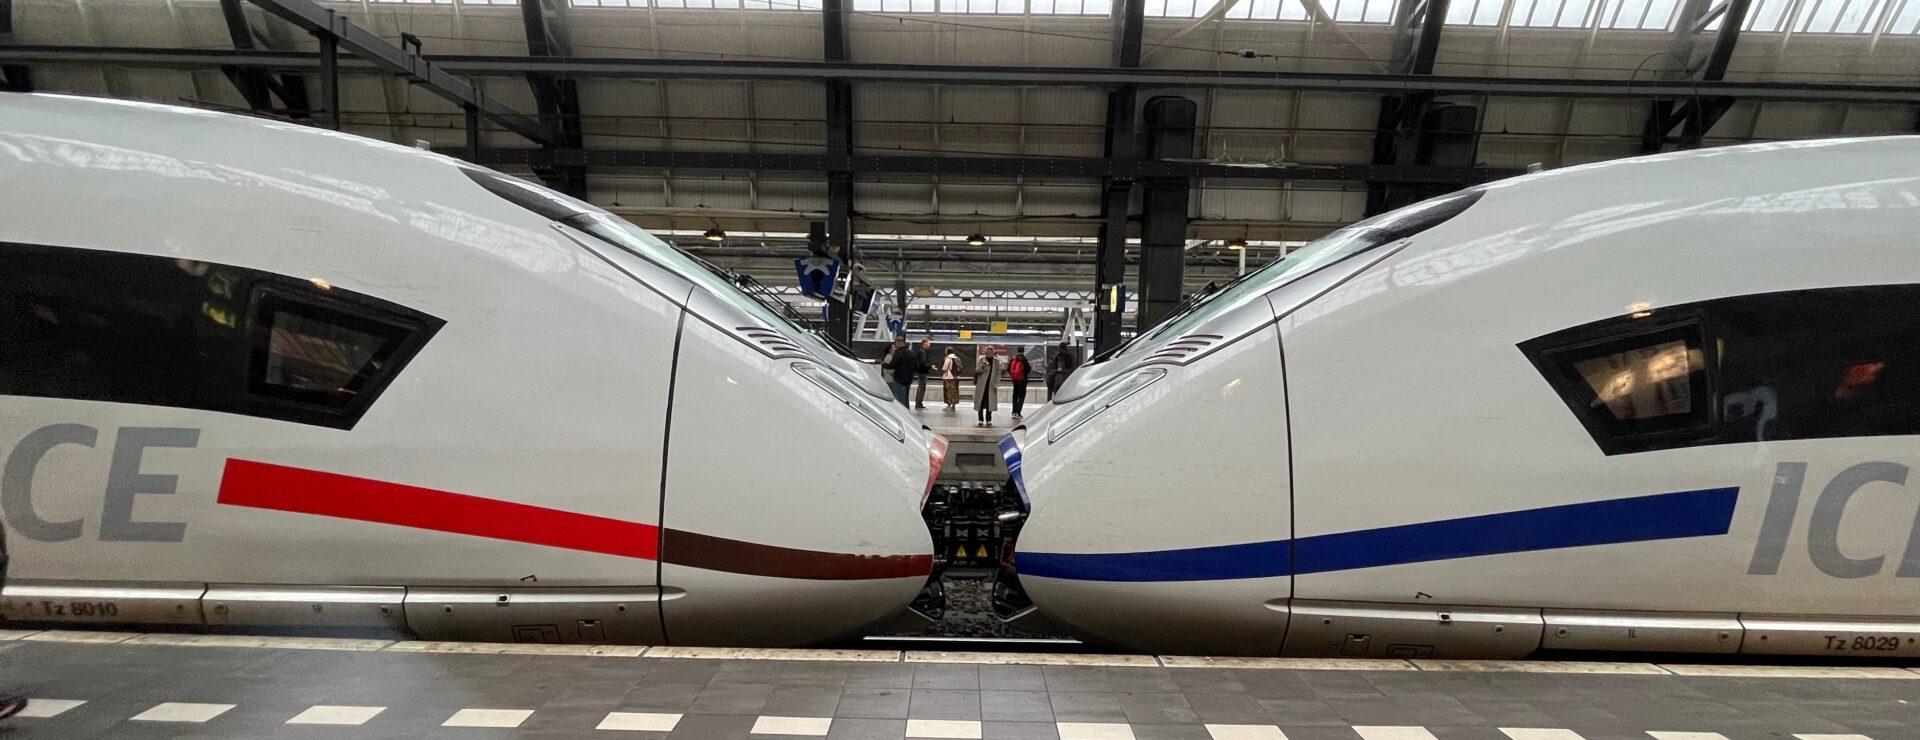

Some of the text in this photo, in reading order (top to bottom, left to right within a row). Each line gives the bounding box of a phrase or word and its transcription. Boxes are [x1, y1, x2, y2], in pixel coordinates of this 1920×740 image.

[1746, 461, 1920, 580] IC
[41, 601, 118, 617] Tz 8010
[1824, 636, 1900, 652] Tz 8029
